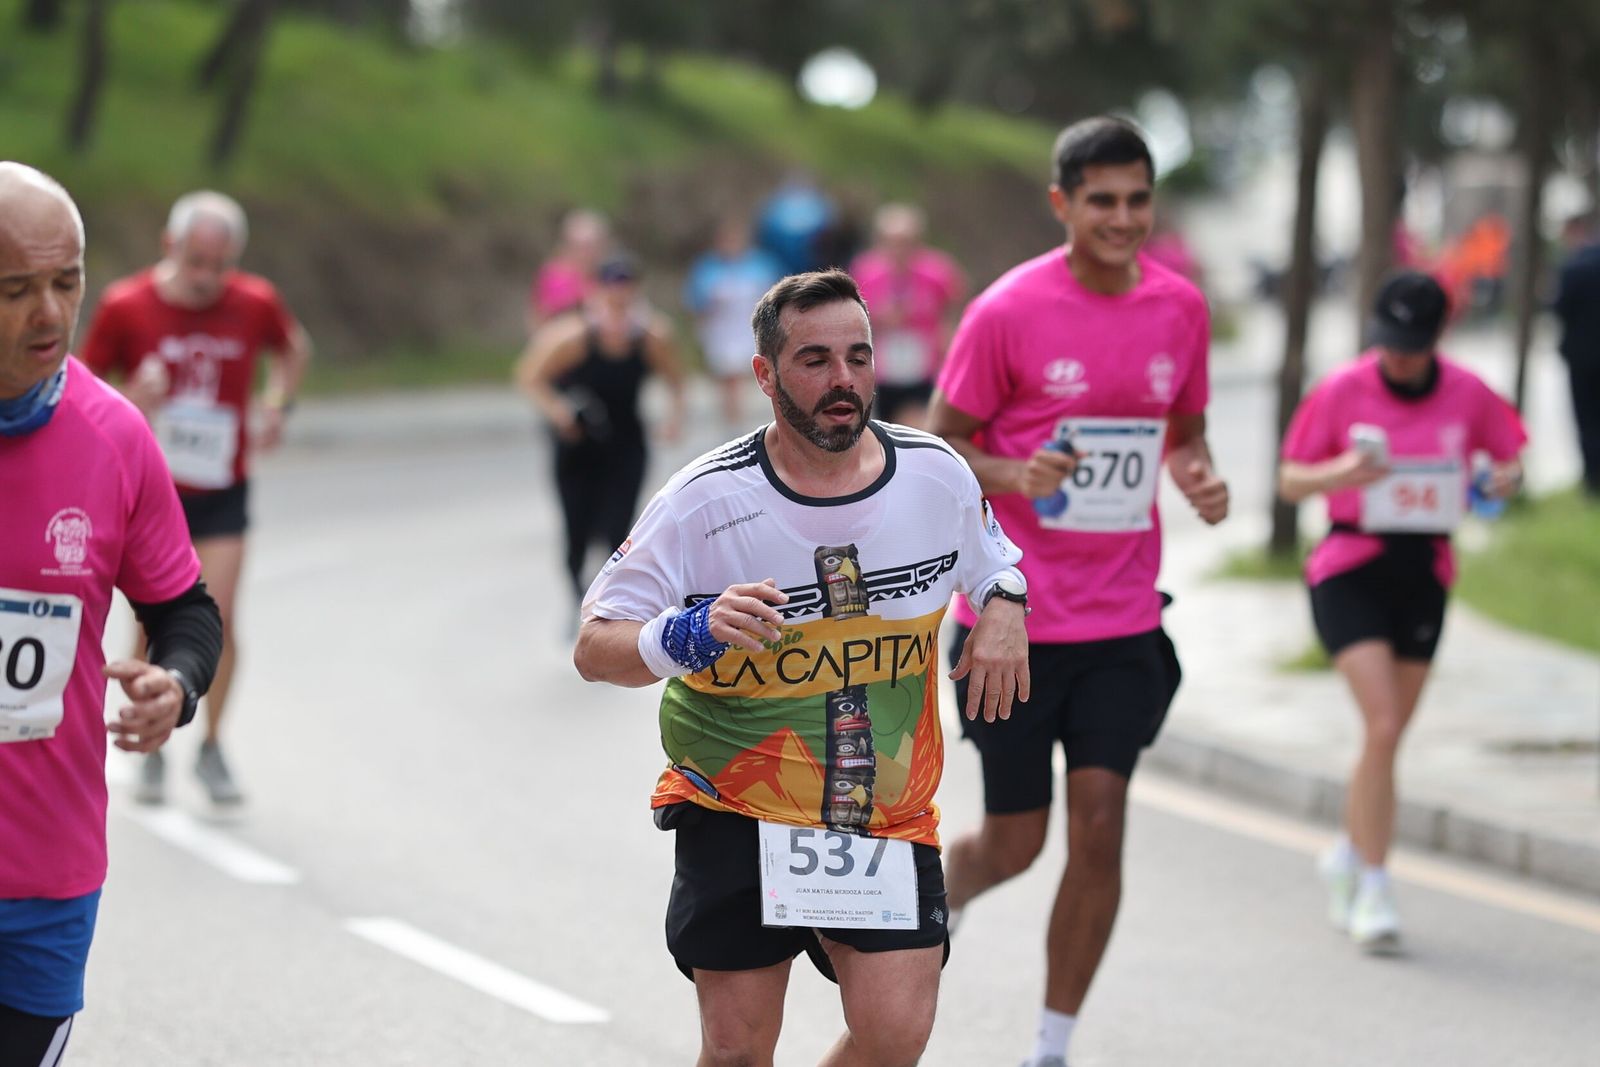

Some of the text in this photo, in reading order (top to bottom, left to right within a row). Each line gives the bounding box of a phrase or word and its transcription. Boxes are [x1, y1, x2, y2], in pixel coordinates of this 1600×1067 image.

[1072, 451, 1144, 488] 670
[705, 509, 767, 540] FIREHAWK
[0, 637, 45, 690] 0
[711, 656, 766, 688] LA
[789, 828, 889, 878] 537
